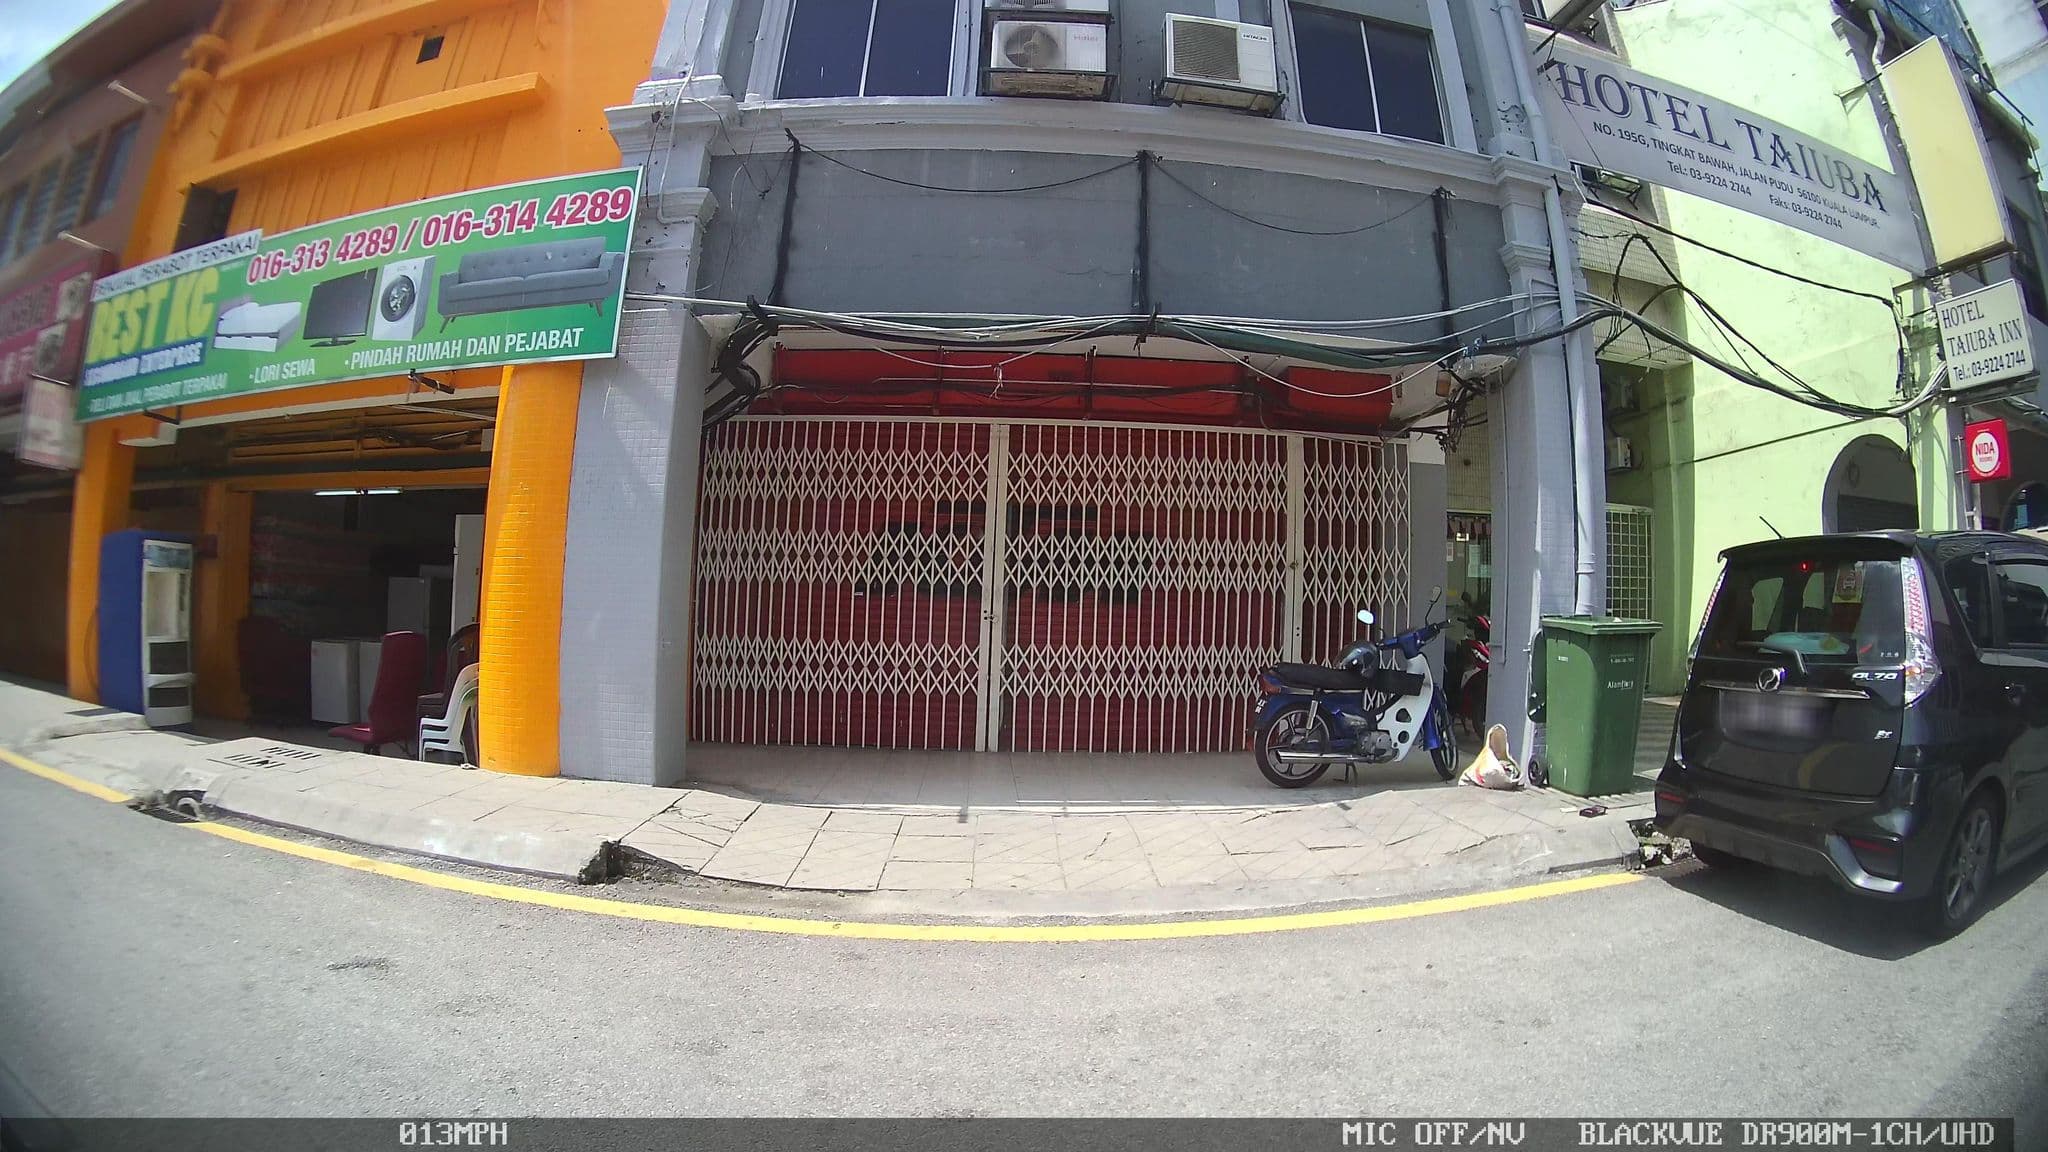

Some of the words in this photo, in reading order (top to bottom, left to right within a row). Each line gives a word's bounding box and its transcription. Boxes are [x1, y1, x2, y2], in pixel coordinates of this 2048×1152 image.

[1555, 58, 1733, 151] HOTEL
[1734, 118, 1888, 213] TAIUBA
[1593, 122, 1616, 136] NO.
[1618, 128, 1650, 149] 195G,
[1650, 137, 1697, 159] TINGKAT
[1697, 152, 1738, 177] BAWAH,
[1739, 166, 1768, 185] JALAN
[1768, 177, 1794, 194] PUDU
[1797, 187, 1822, 205] 56100
[1822, 197, 1848, 214] KUALA
[1689, 168, 1728, 189] 03-9224
[1730, 179, 1752, 197] 2744
[1769, 194, 1791, 210] Faks:
[1791, 202, 1823, 221] 03-9224
[1824, 214, 1843, 229] 2744
[197, 234, 259, 264] TERPAKAI
[247, 239, 330, 284] 016-313
[336, 223, 400, 263] 4289
[401, 219, 419, 253] /
[421, 198, 540, 248] 016-314
[544, 185, 635, 230] 4289
[85, 277, 170, 364] BEST
[165, 265, 220, 343] KC
[1941, 299, 1985, 330] HOTEL
[405, 338, 461, 364] RUMAH
[465, 334, 501, 358] DAN
[503, 326, 585, 353] PEJABAT
[1946, 326, 1998, 358] TAIUBA
[1998, 317, 2023, 342] INN
[281, 357, 316, 380] SEWA
[1971, 354, 2005, 377] 03-9224
[2004, 349, 2026, 370] 2744
[181, 373, 228, 396] TERPAKAI
